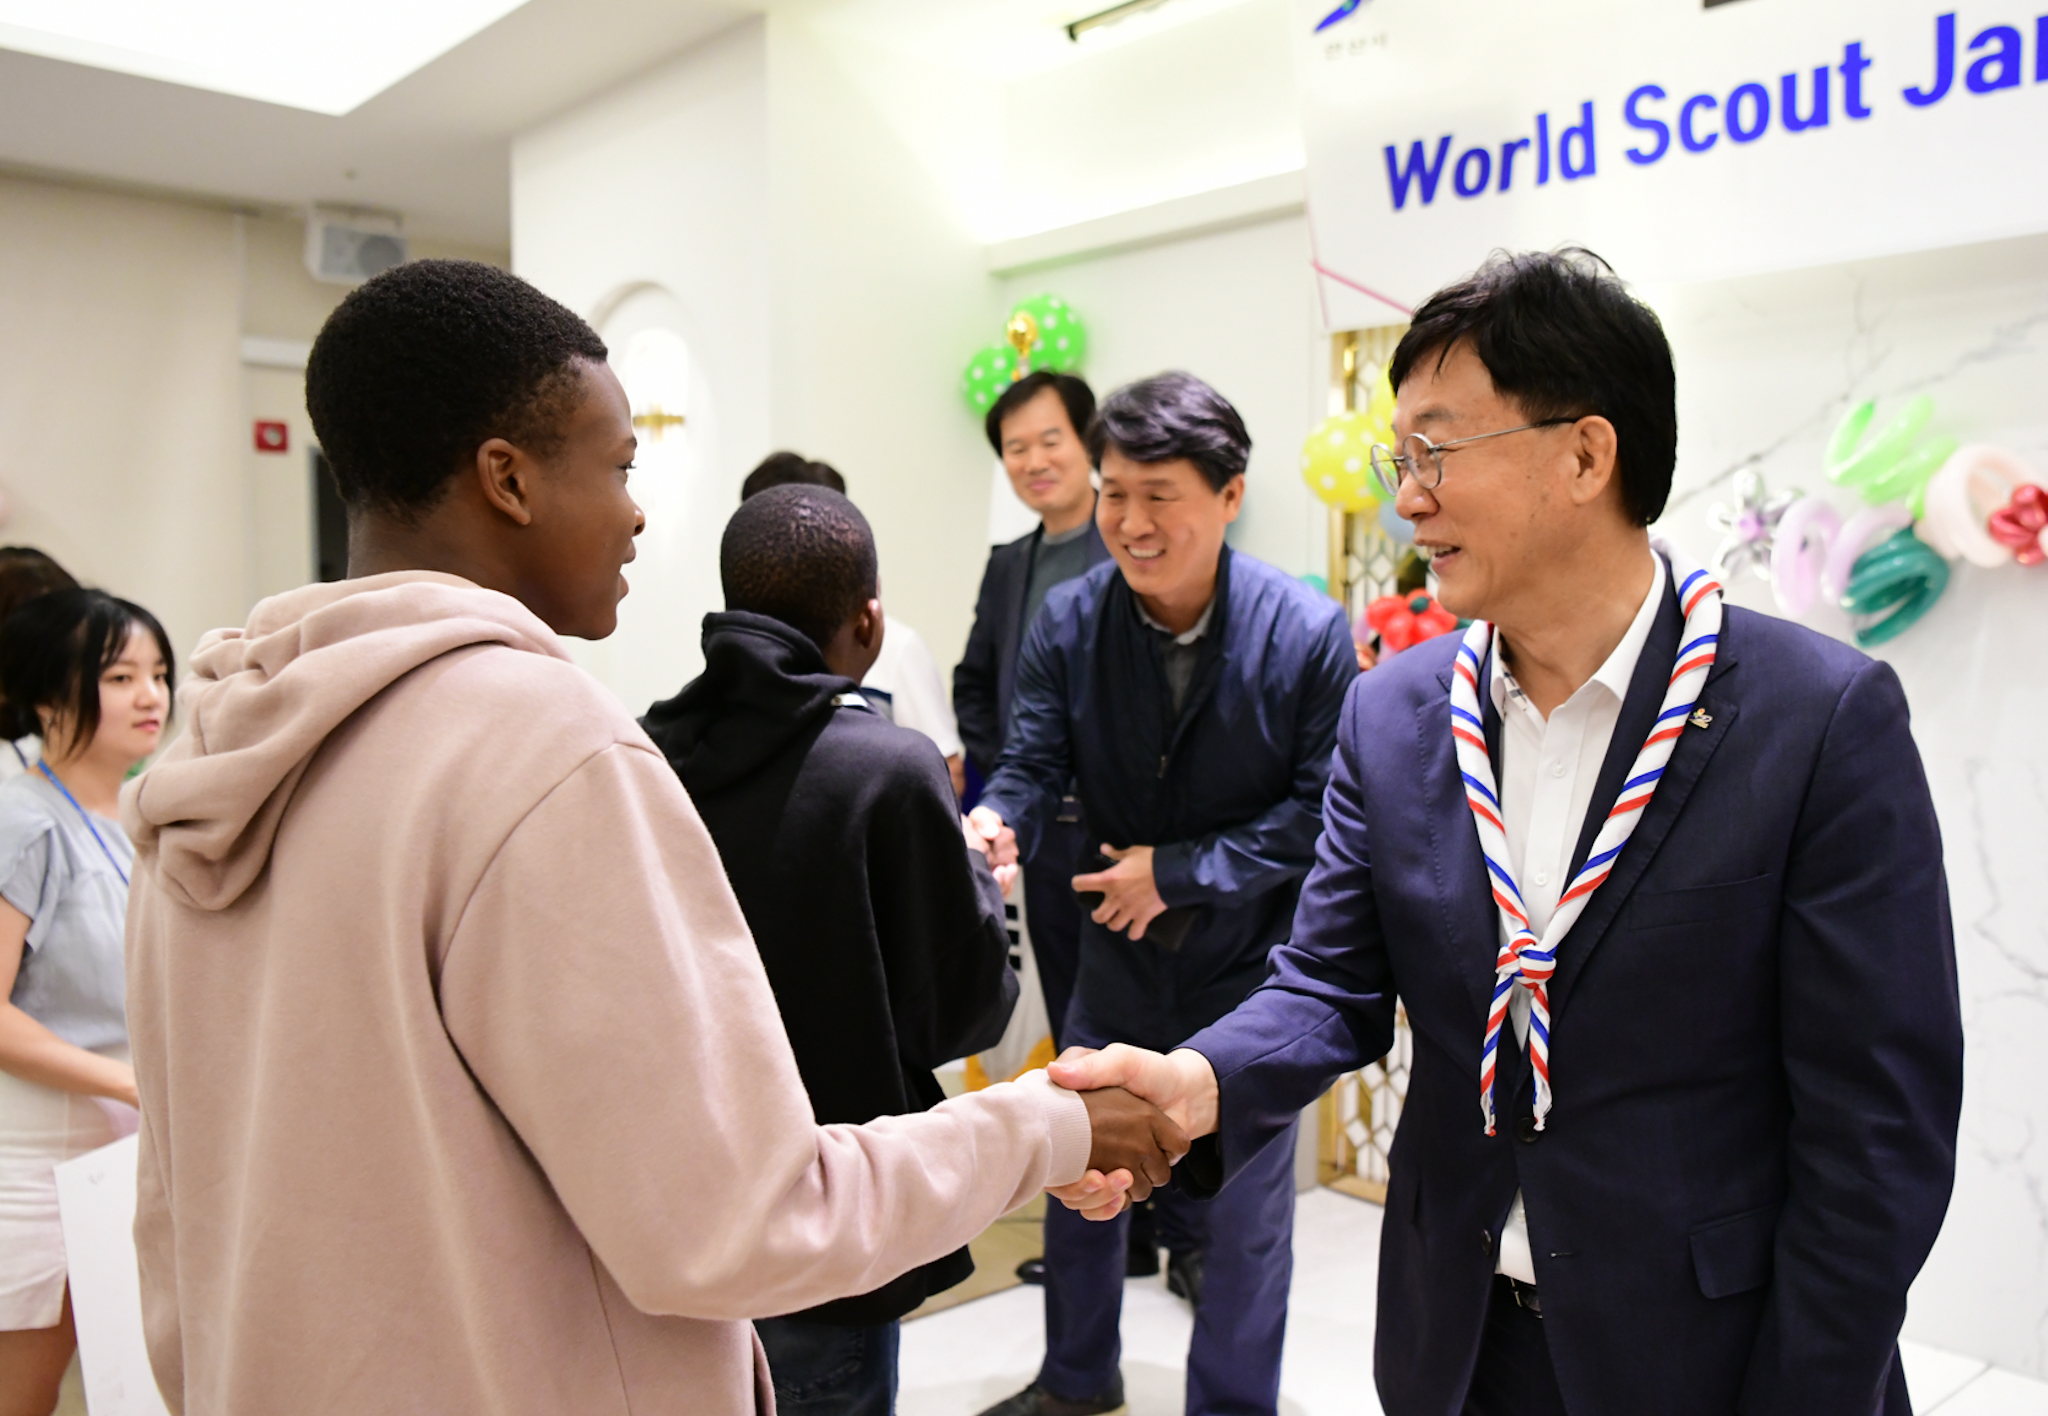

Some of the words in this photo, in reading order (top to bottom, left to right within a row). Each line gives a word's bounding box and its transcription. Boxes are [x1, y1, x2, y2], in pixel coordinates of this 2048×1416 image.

[1385, 101, 1597, 210] World
[1624, 42, 1872, 165] Scout
[1902, 13, 2048, 108] Ja
